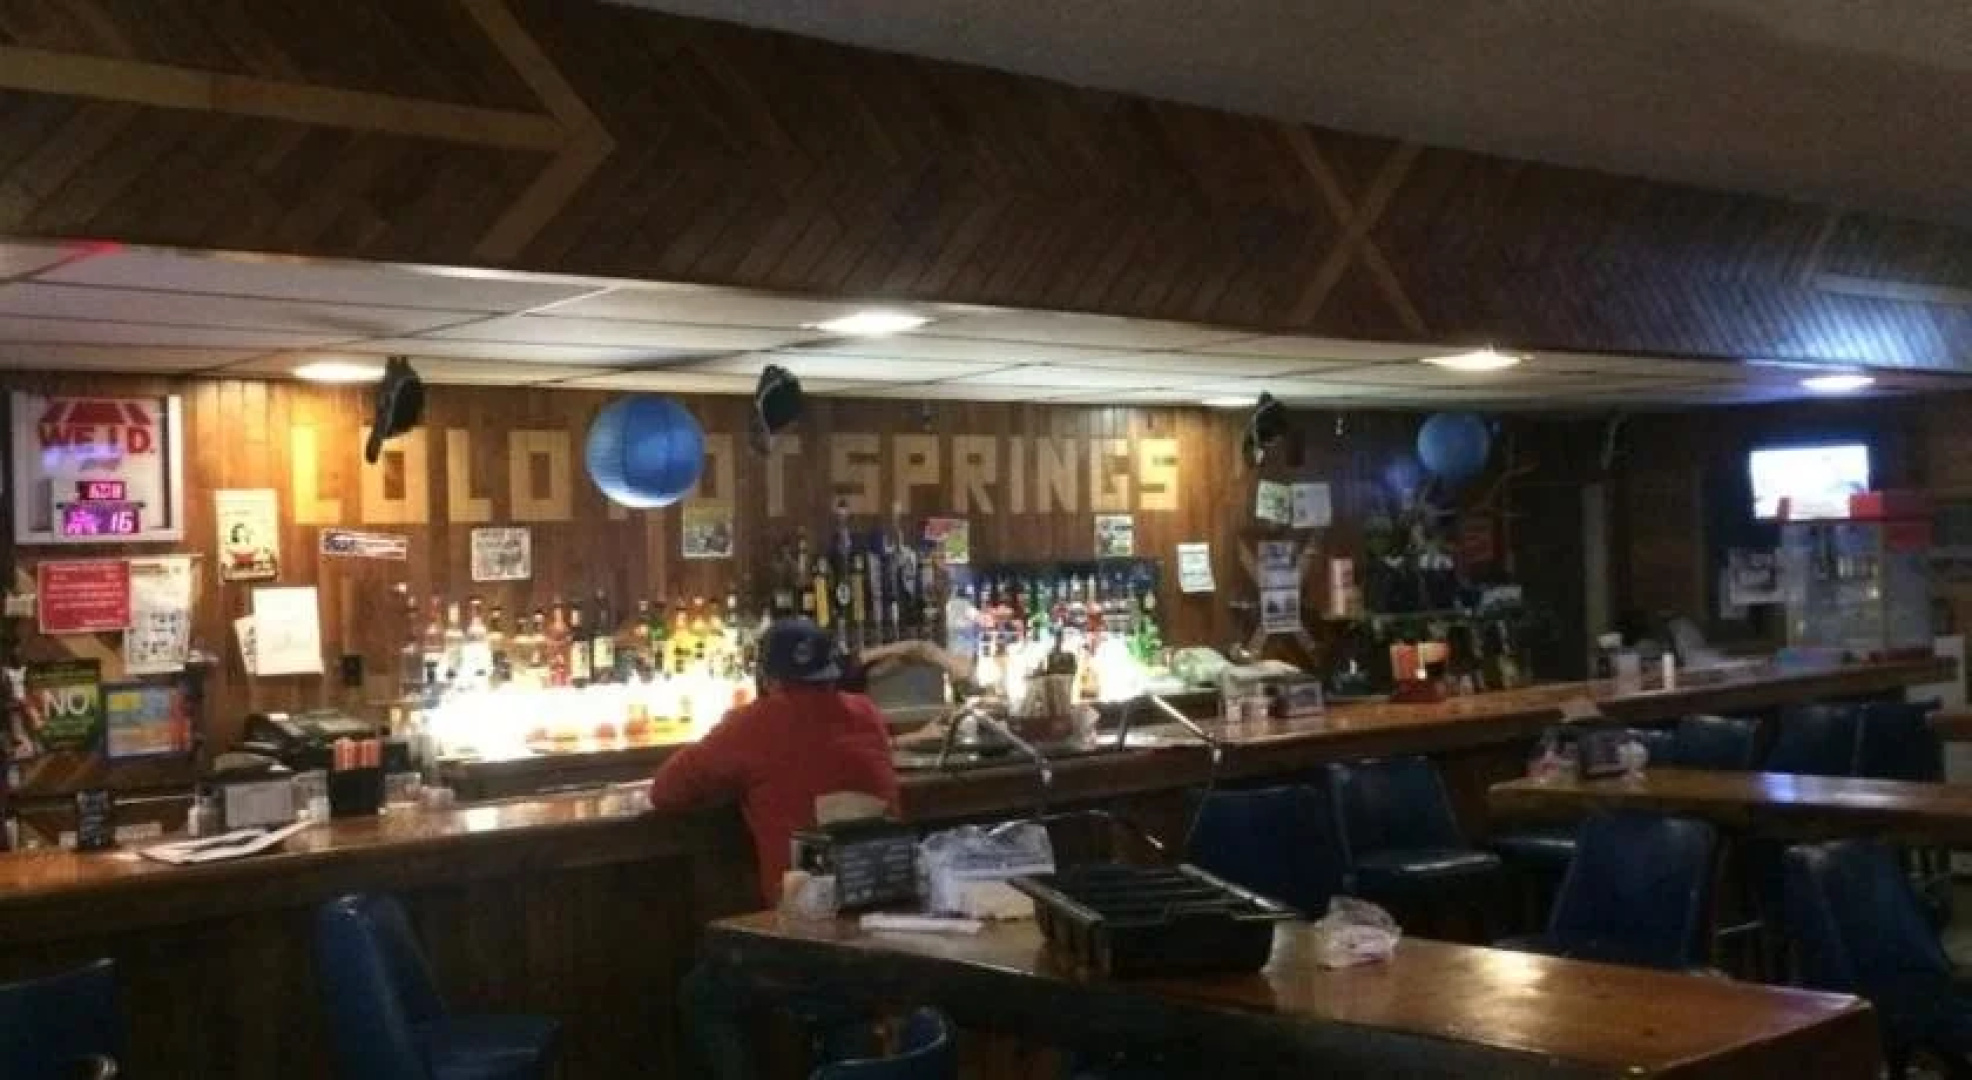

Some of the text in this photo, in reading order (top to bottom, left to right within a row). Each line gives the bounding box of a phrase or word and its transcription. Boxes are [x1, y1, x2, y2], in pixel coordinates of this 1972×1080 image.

[291, 425, 572, 524] LOLO
[829, 432, 1179, 513] SPRINGS
[43, 688, 90, 717] NO
